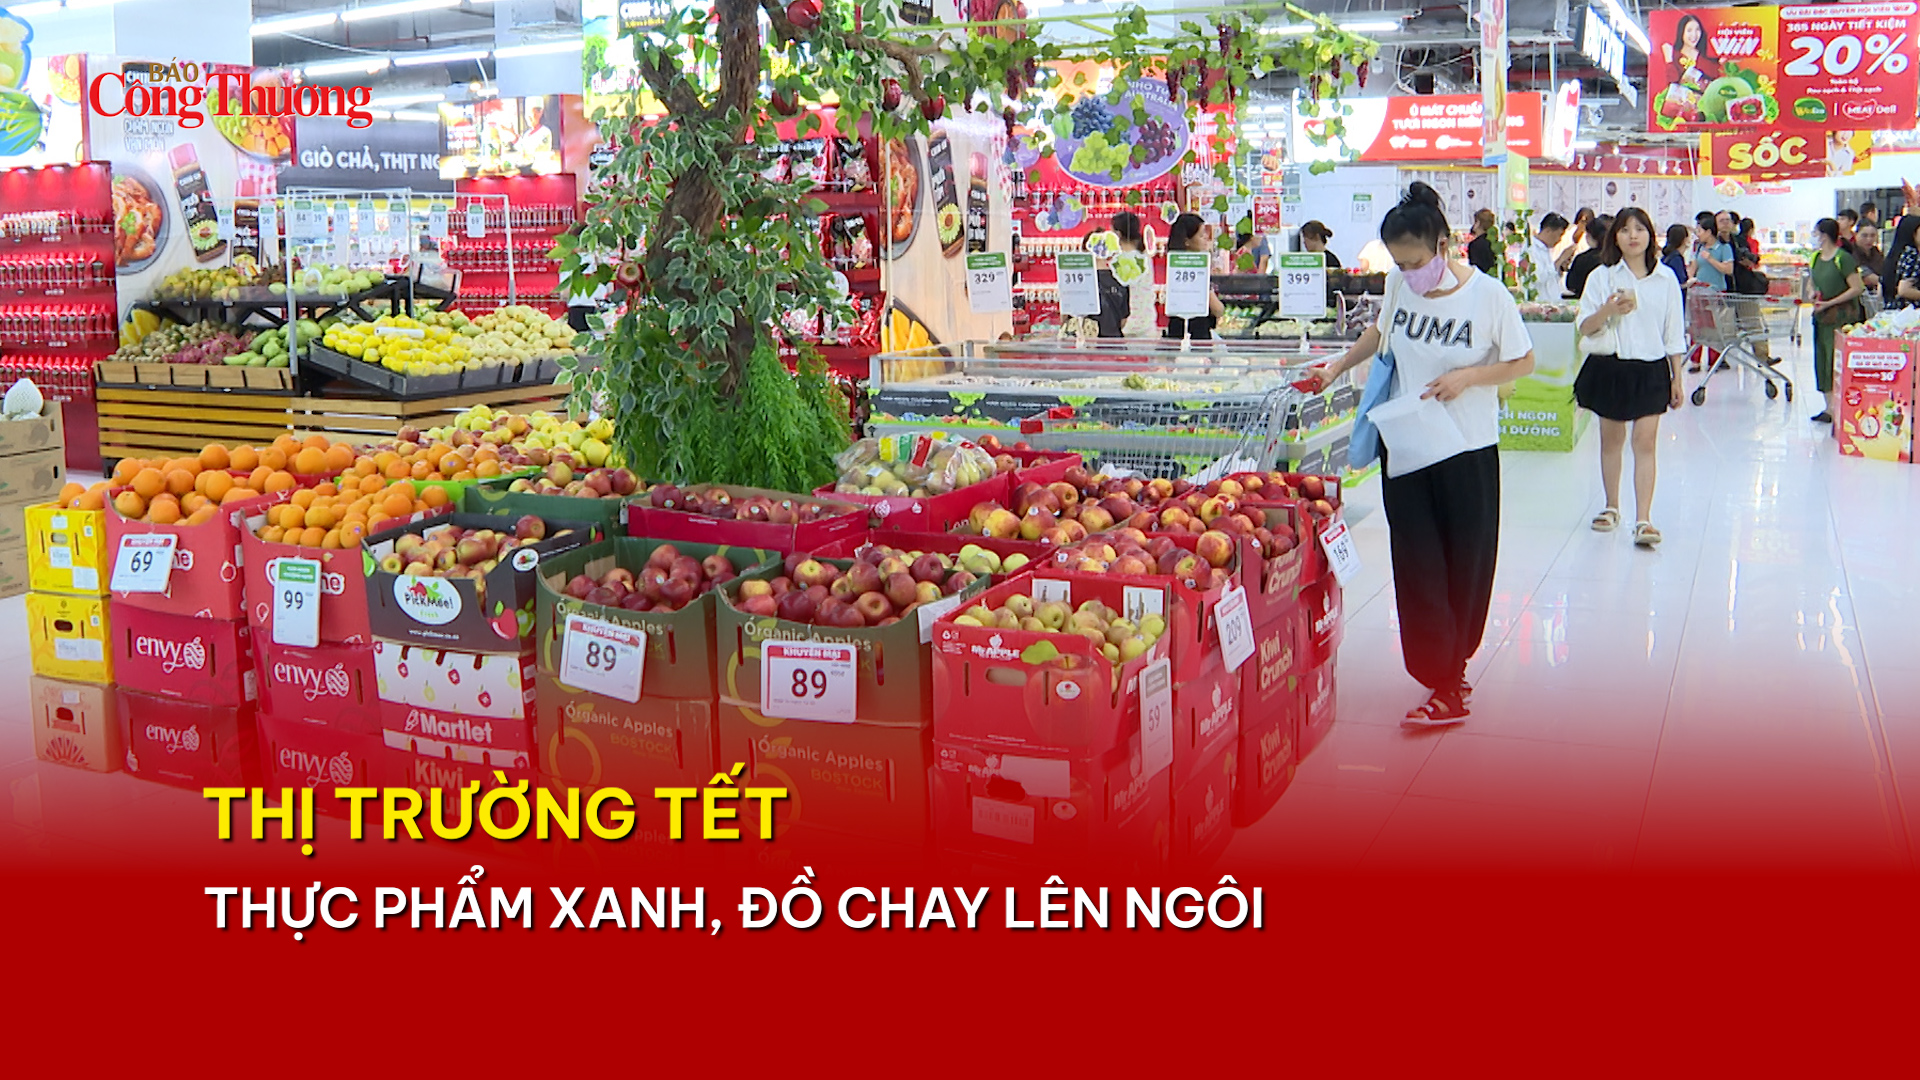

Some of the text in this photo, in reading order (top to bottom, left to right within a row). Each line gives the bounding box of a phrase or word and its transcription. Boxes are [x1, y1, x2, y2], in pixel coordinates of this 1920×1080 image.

[1847, 16, 1873, 29] TIẾT
[1875, 17, 1907, 30] KIỆM
[1784, 33, 1909, 76] 20%
[300, 144, 334, 169] GIÒ
[336, 145, 380, 172] CHẢ,
[380, 153, 418, 173] THỊT
[1727, 131, 1808, 170] SỐC
[1391, 307, 1473, 349] PUMA
[130, 550, 153, 573] 69
[284, 590, 304, 610] 99
[1226, 616, 1242, 645] 209
[136, 636, 185, 674] envy
[586, 641, 617, 671] 89
[274, 662, 329, 701] envy
[791, 668, 827, 699] 89
[146, 724, 184, 753] envy
[420, 713, 492, 744] Martlet
[622, 716, 673, 738] Apples
[825, 750, 883, 771] Apples
